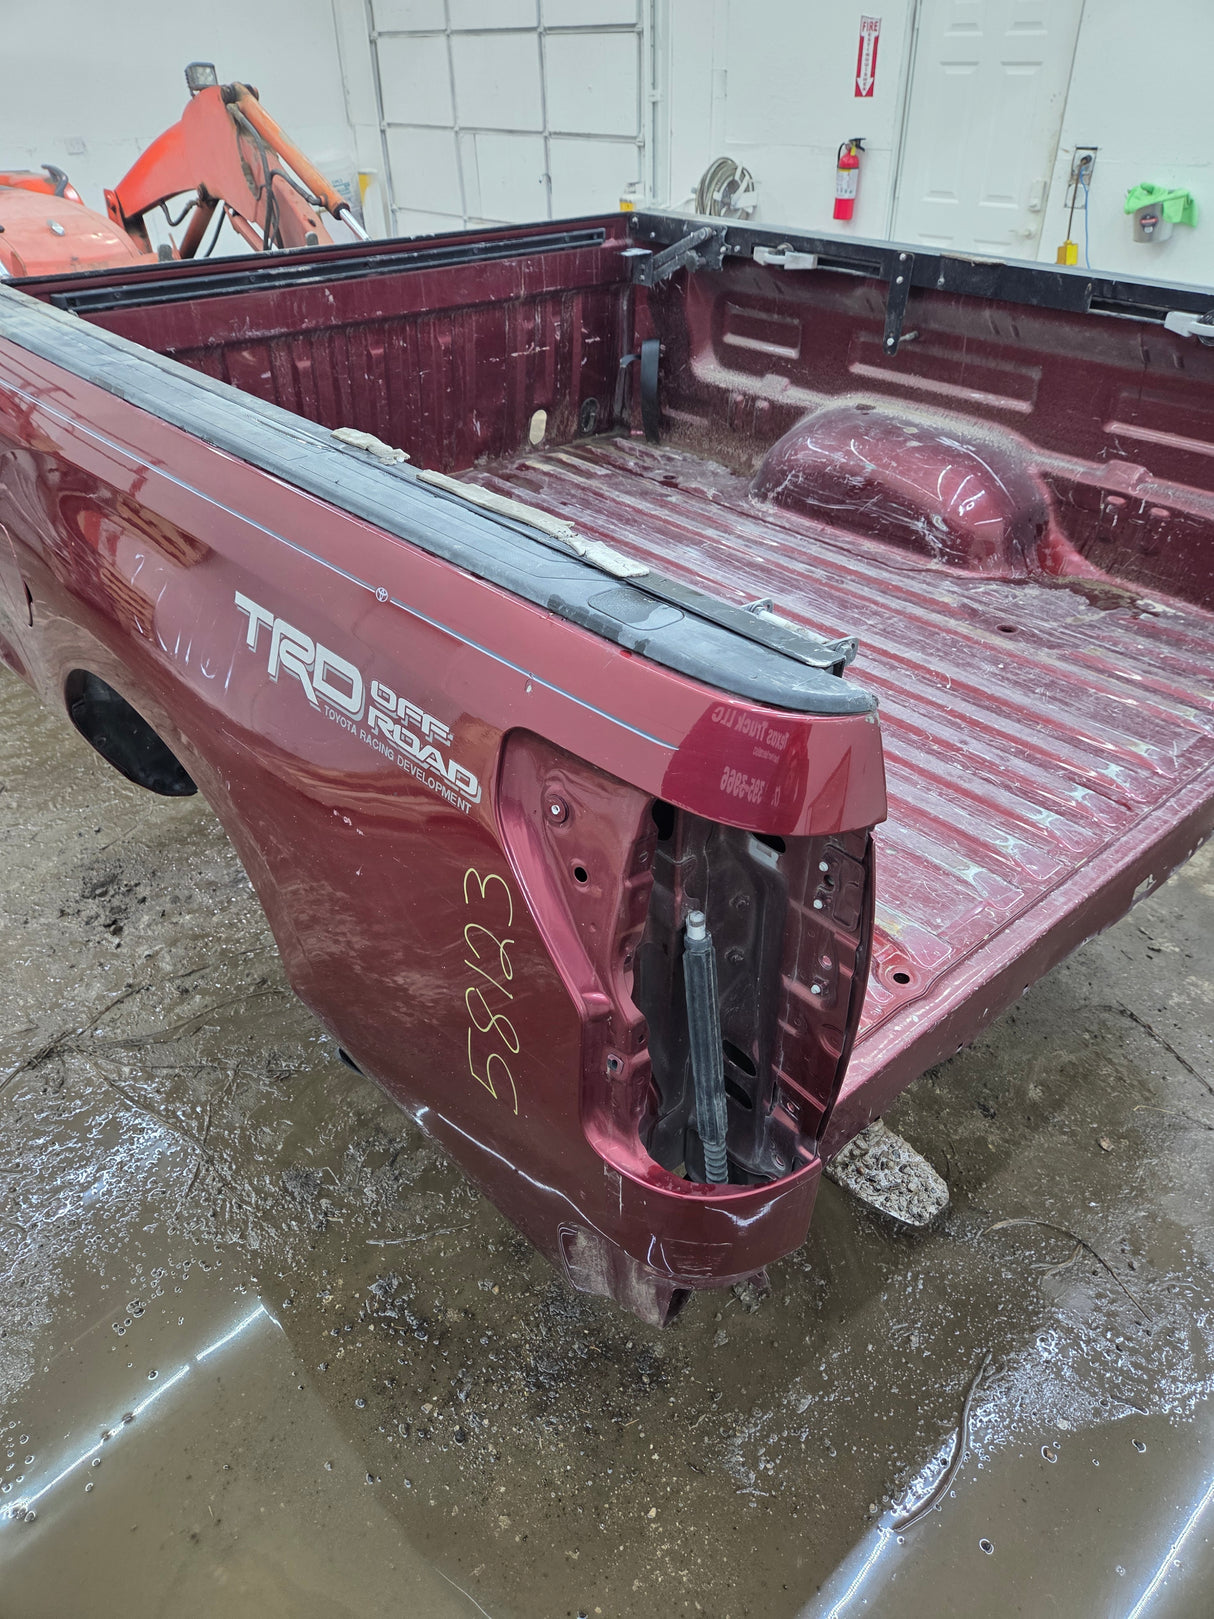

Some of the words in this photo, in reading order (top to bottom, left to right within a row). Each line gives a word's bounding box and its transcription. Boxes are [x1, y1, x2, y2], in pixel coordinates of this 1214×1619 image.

[862, 20, 878, 32] FIRE
[234, 589, 365, 721] TRD
[323, 704, 358, 736] TOYOTA
[359, 728, 394, 761] RACING
[396, 754, 472, 815] DEVELOPMENT
[367, 705, 482, 803] ROAD
[370, 680, 453, 746] OFF
[463, 867, 520, 1116] 58123
